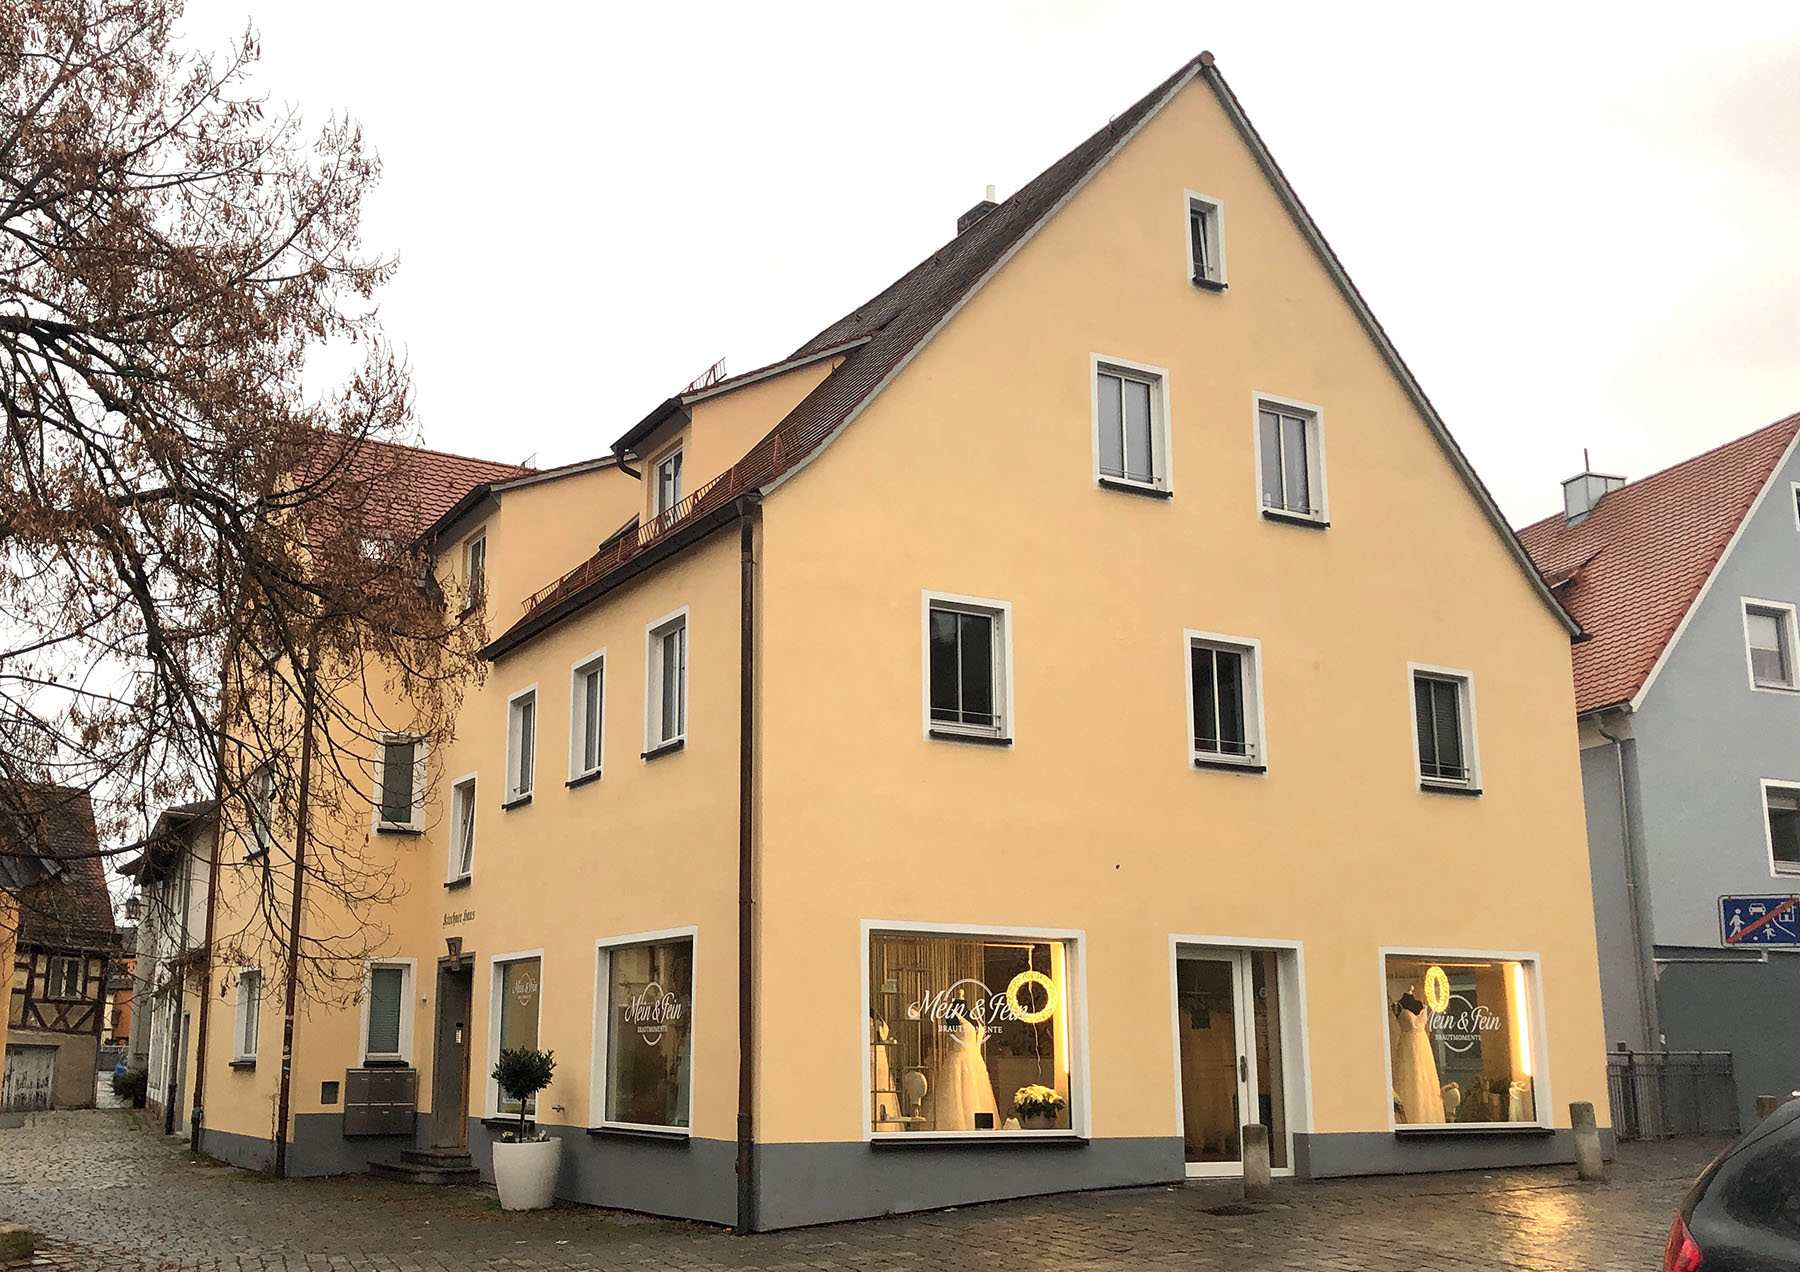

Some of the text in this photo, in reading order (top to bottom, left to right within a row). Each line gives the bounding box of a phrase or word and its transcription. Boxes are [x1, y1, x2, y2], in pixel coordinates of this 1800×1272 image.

[624, 992, 682, 1025] Mein & Fein
[907, 990, 966, 1022] Mein
[969, 998, 986, 1024] &
[1457, 1011, 1469, 1032] &
[1470, 1005, 1502, 1033] Fein
[938, 1024, 1003, 1034] BRAUTENTE
